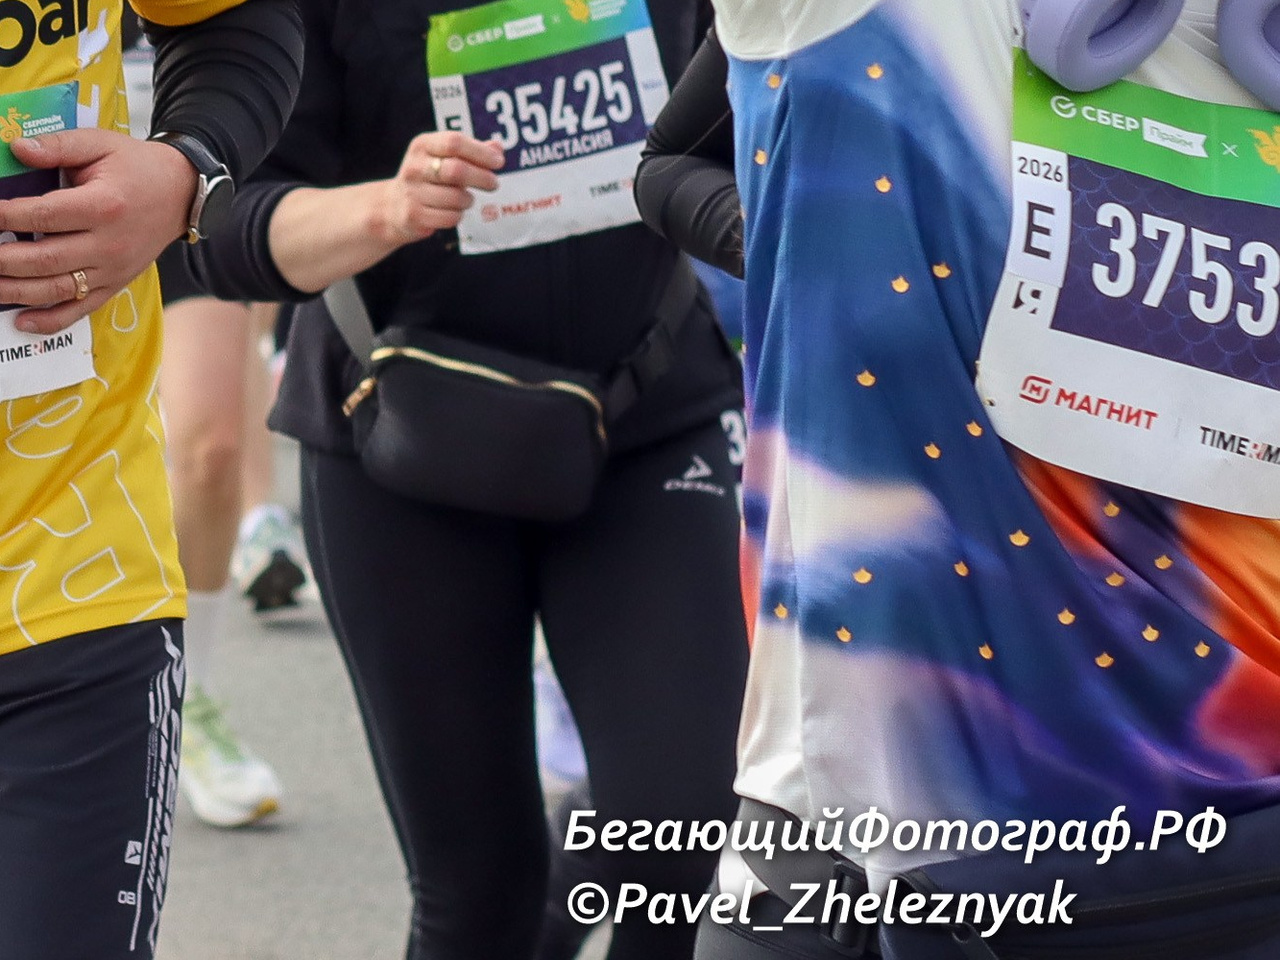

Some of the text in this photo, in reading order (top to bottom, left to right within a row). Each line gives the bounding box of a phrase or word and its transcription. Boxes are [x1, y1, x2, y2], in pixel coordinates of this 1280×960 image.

[485, 61, 633, 151] 35425
[1081, 105, 1140, 131] СБЕР
[520, 129, 614, 168] АНАСТАСИЯ
[1018, 156, 1063, 183] 2026
[1023, 201, 1055, 260] E
[1054, 387, 1159, 430] МАГНИТ
